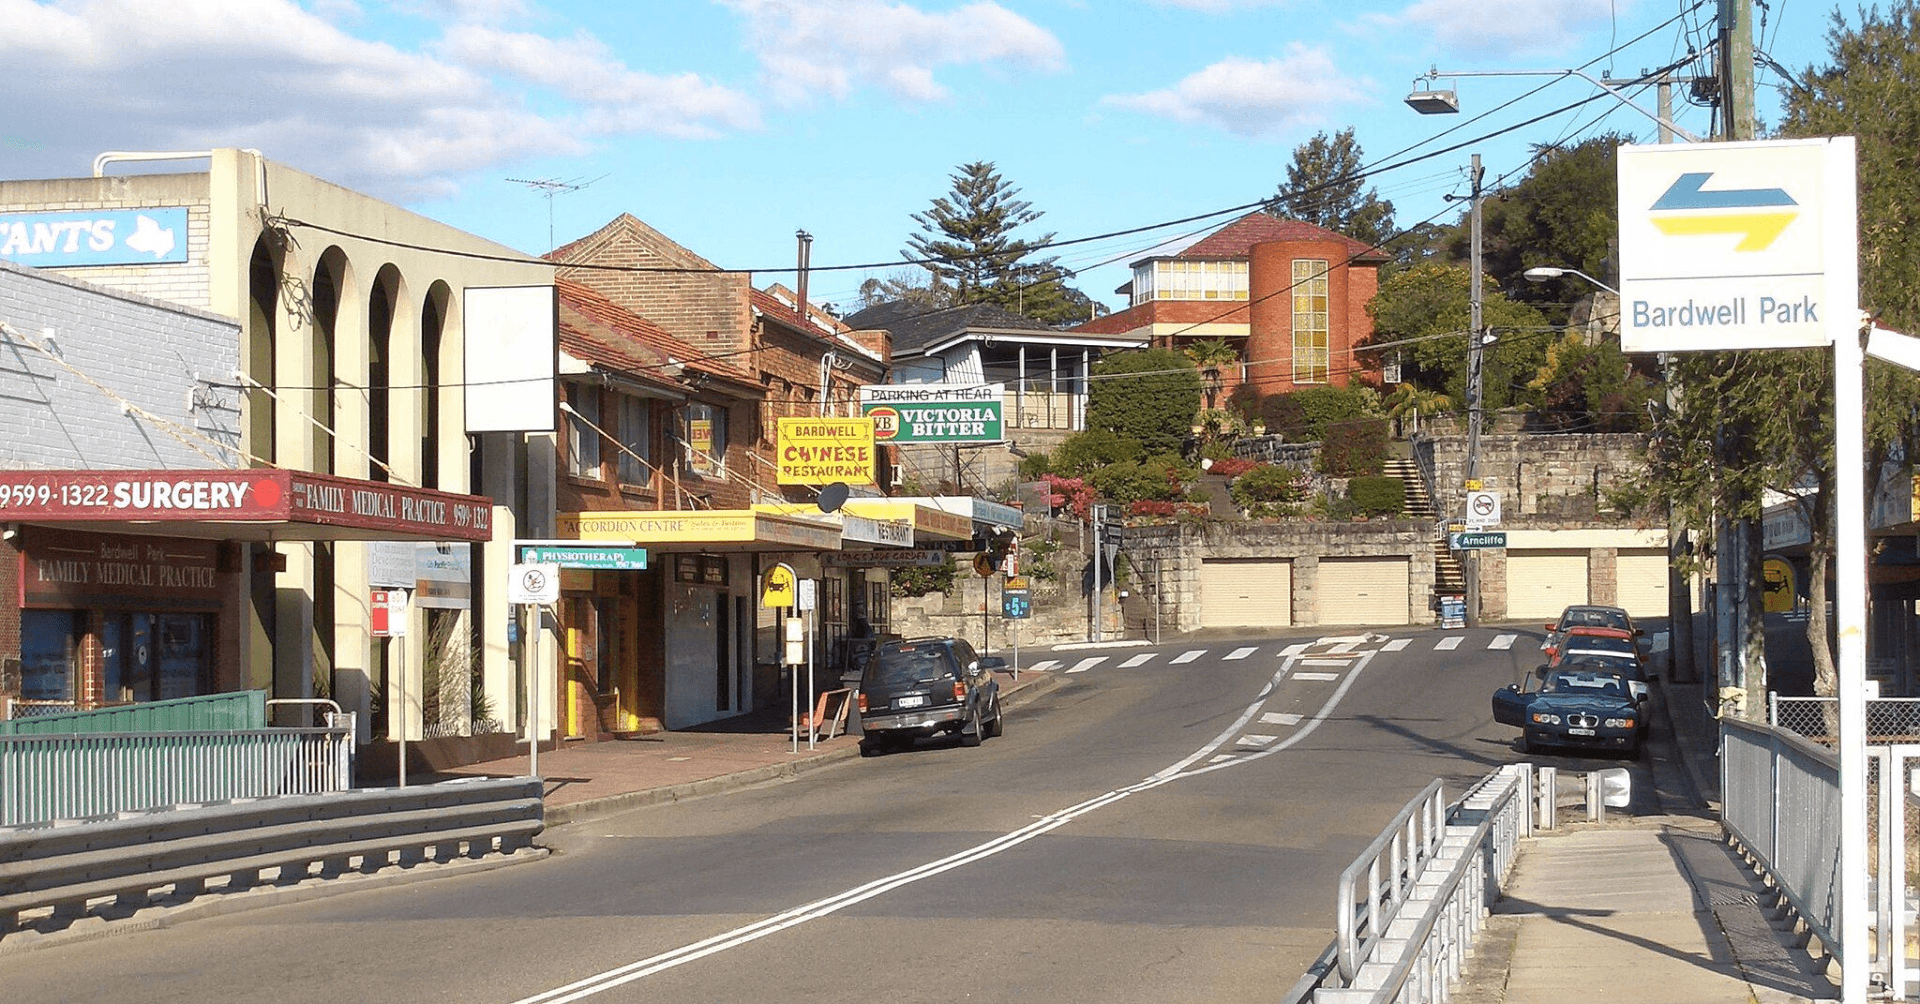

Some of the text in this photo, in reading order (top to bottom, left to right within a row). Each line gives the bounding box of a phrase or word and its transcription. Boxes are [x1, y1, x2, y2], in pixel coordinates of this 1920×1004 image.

[0, 219, 116, 255] ANTS
[1633, 295, 1819, 328] Bardwell Park
[871, 388, 992, 401] PARKING AT REAR
[900, 407, 997, 423] VICTORIA
[795, 425, 857, 437] BARDWELL
[912, 422, 986, 436] BITTER
[784, 446, 869, 462] CHINESE
[783, 465, 870, 477] RESTAURANT
[113, 481, 249, 509] SURGERY
[306, 483, 346, 513] FAMILY
[351, 489, 397, 519] MEDICAL
[878, 522, 910, 544] RESTAURANT
[1462, 536, 1504, 545] Arncliffe
[542, 551, 626, 562] PHYSIOTHERAPY
[38, 559, 216, 588] FAMILY MEDICAL PRACTICE
